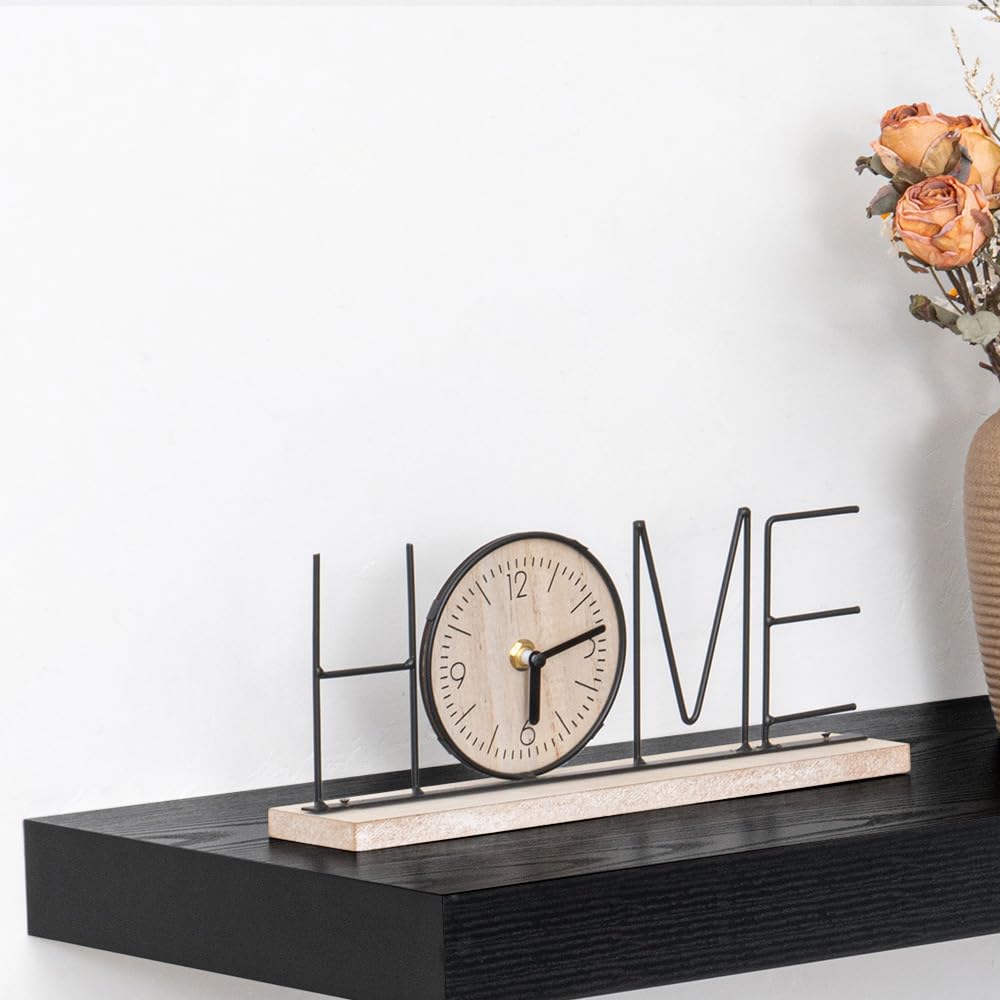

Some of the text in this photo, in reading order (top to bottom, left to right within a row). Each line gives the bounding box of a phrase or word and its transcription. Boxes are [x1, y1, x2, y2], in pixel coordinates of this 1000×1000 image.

[507, 571, 528, 600] 12
[313, 506, 860, 811] HOME
[450, 661, 467, 690] 9
[520, 720, 535, 745] 6
